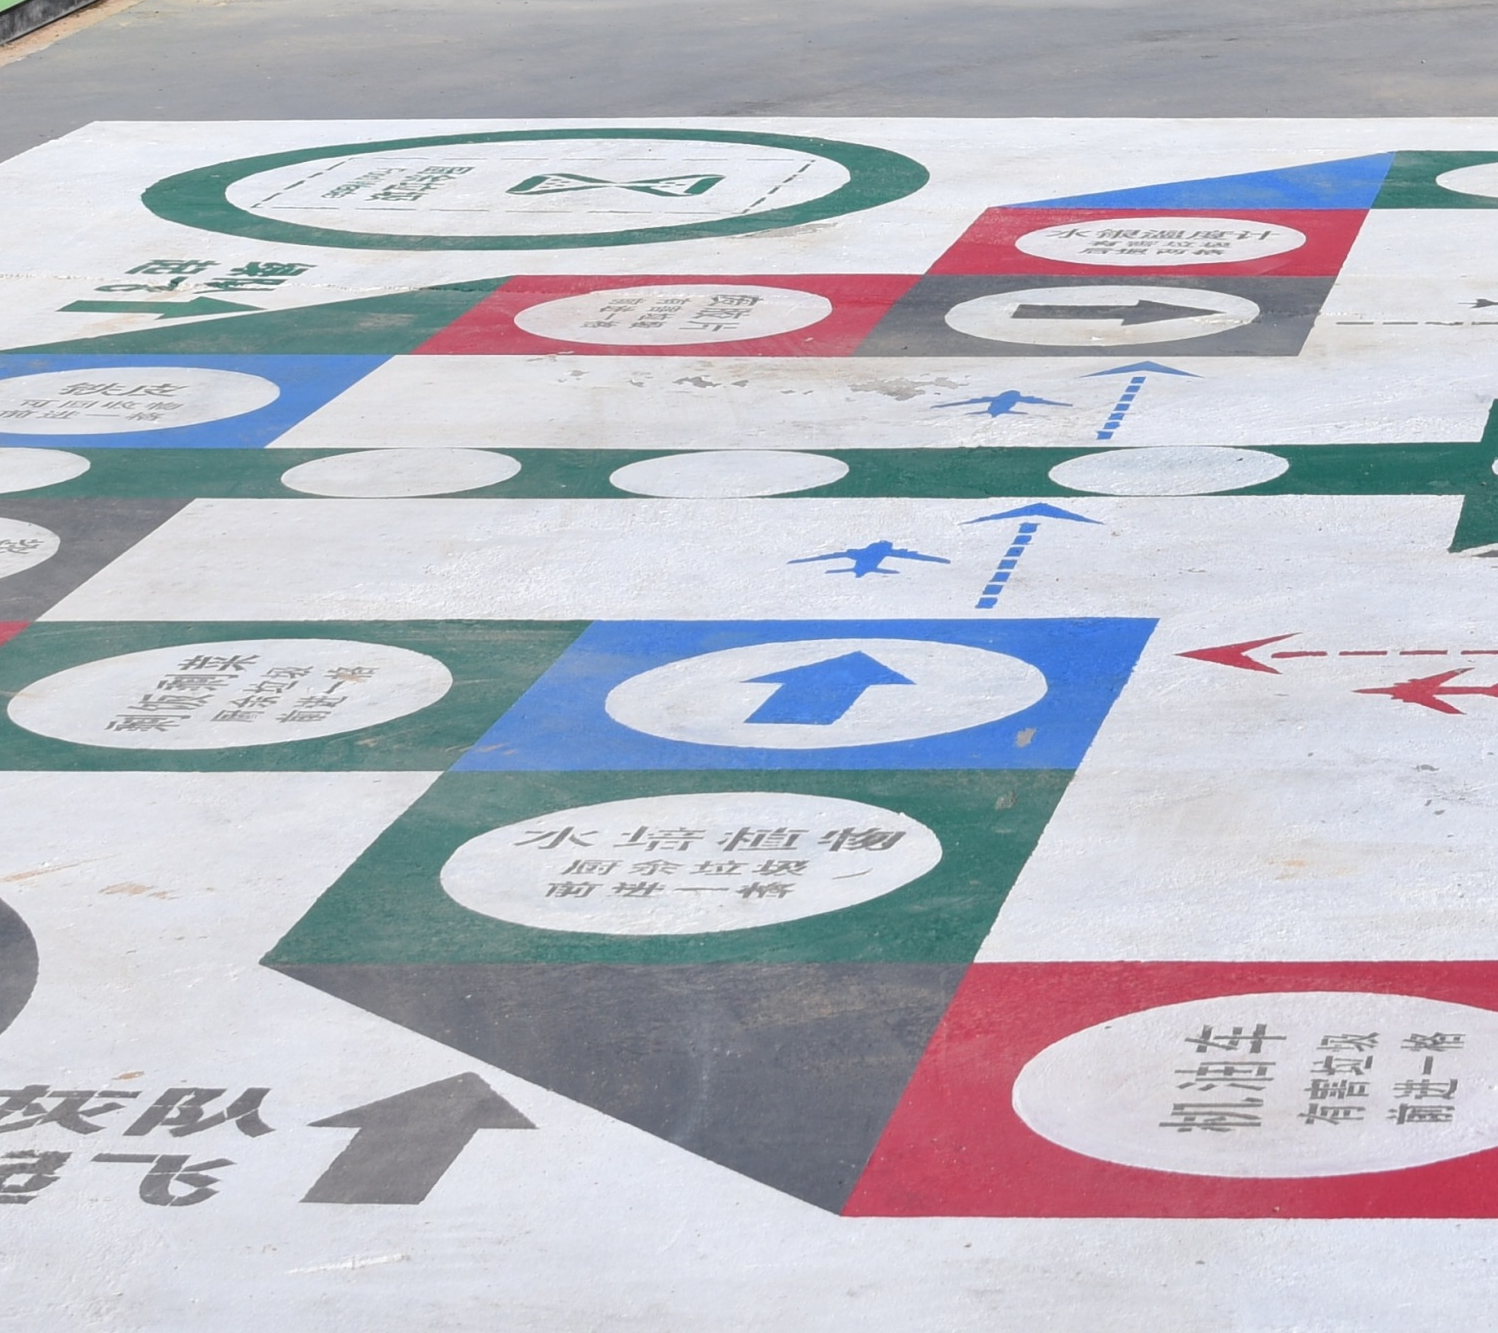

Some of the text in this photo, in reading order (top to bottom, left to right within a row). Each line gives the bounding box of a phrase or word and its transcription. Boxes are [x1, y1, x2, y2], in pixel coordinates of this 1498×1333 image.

[1045, 227, 1280, 242] 水银温度计
[193, 262, 317, 294] 绿队
[679, 294, 763, 332] 废胶片
[19, 399, 184, 410] 可回收物
[58, 380, 188, 398] 铁皮
[104, 651, 259, 733] 剩饭剩菜
[209, 663, 314, 724] 厨余垃圾
[277, 665, 378, 725] 前进一格
[513, 827, 908, 853] 水培植物
[561, 859, 812, 879] 厨余垃圾
[544, 881, 796, 900] 前进一格
[1159, 1022, 1287, 1133] 机油车
[1298, 1030, 1380, 1126] 有害垃圾
[1387, 1030, 1467, 1127] 前进一格
